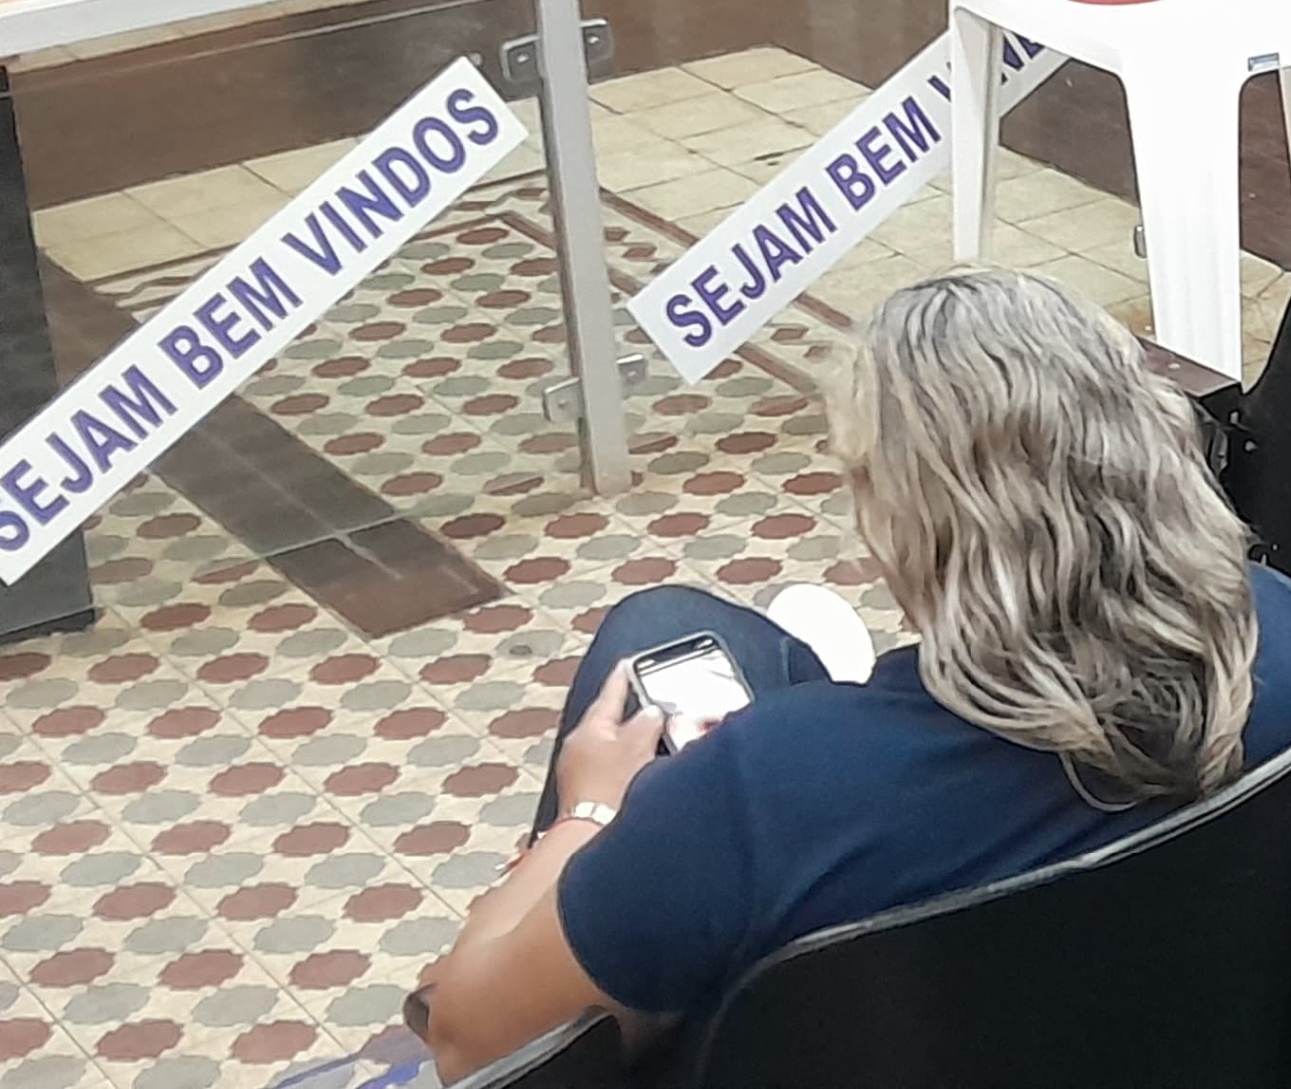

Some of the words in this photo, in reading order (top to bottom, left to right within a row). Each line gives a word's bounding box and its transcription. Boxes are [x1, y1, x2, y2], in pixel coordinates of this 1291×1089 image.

[159, 257, 302, 390] BEM
[282, 88, 499, 276] VINDOS
[666, 186, 838, 348] SEJAM
[825, 96, 941, 210] BEM
